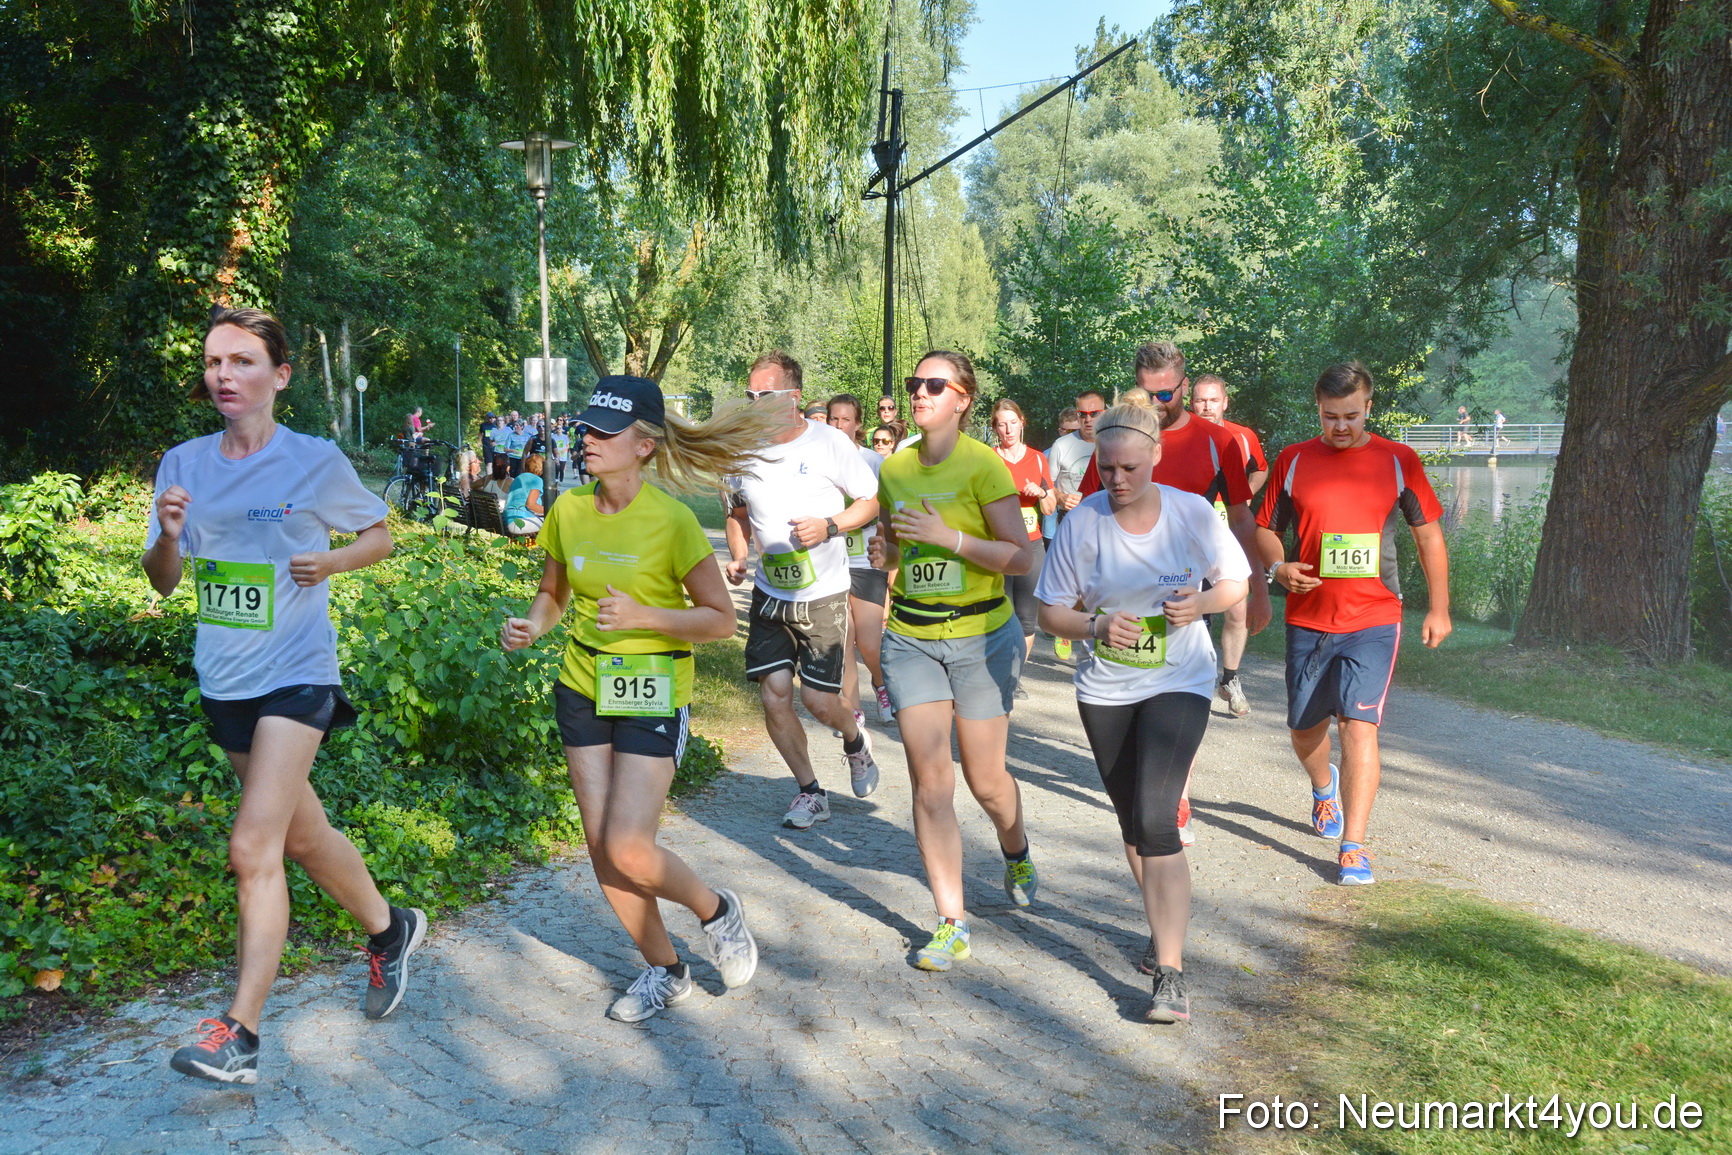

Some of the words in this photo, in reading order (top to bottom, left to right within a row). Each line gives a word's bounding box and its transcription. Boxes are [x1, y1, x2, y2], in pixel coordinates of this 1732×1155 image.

[248, 506, 284, 518] reindl
[1329, 548, 1370, 565] 1161
[774, 564, 802, 580] 478
[912, 561, 948, 584] 907
[1158, 572, 1188, 582] reindl
[203, 582, 262, 611] 1719
[235, 610, 259, 618] Renate
[613, 676, 657, 699] 915
[644, 699, 663, 707] Sylvia
